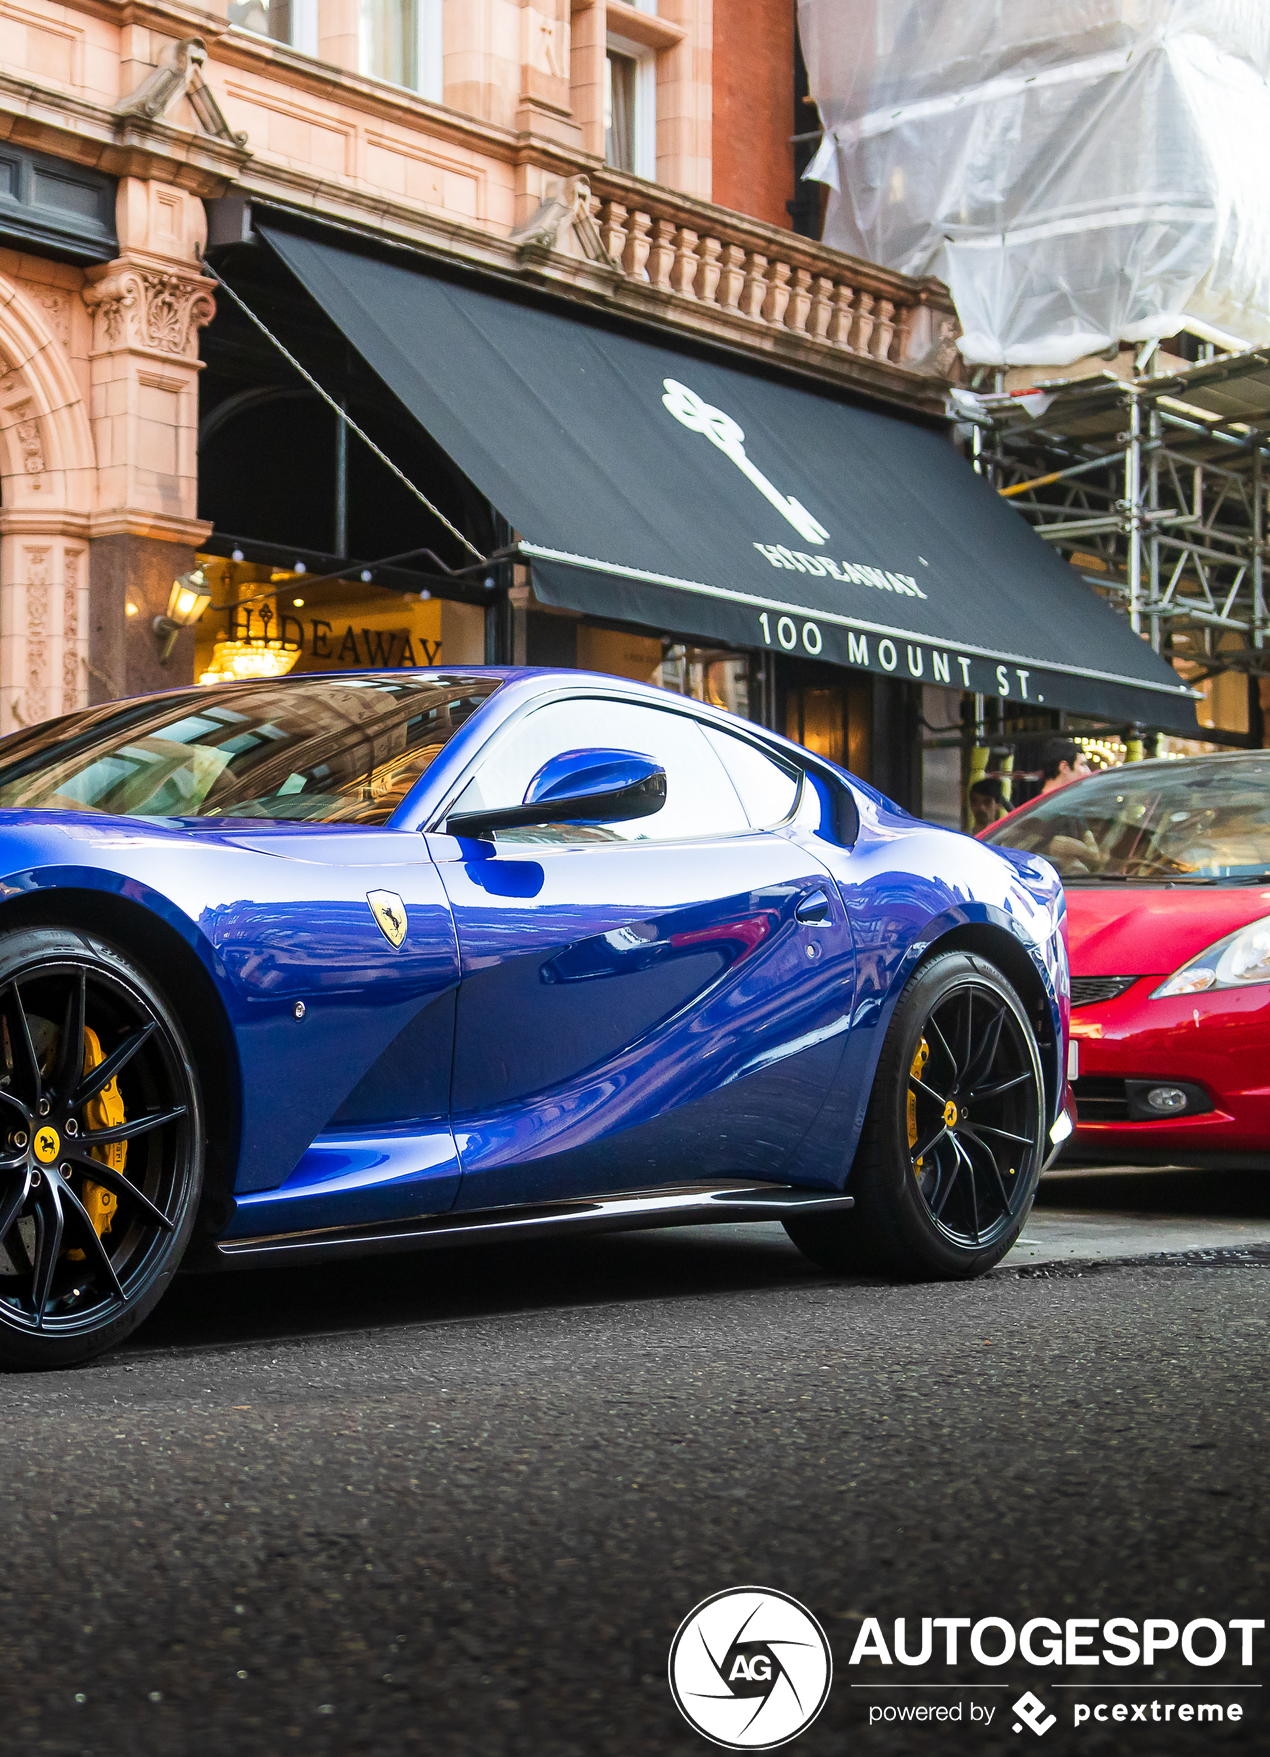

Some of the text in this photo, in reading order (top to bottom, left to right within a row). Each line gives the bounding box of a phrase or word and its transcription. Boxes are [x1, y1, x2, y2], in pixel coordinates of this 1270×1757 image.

[752, 542, 929, 600] HIDEAWAY
[230, 603, 443, 667] HIDEAWAY
[758, 612, 1045, 703] 100 MOUNT ST.
